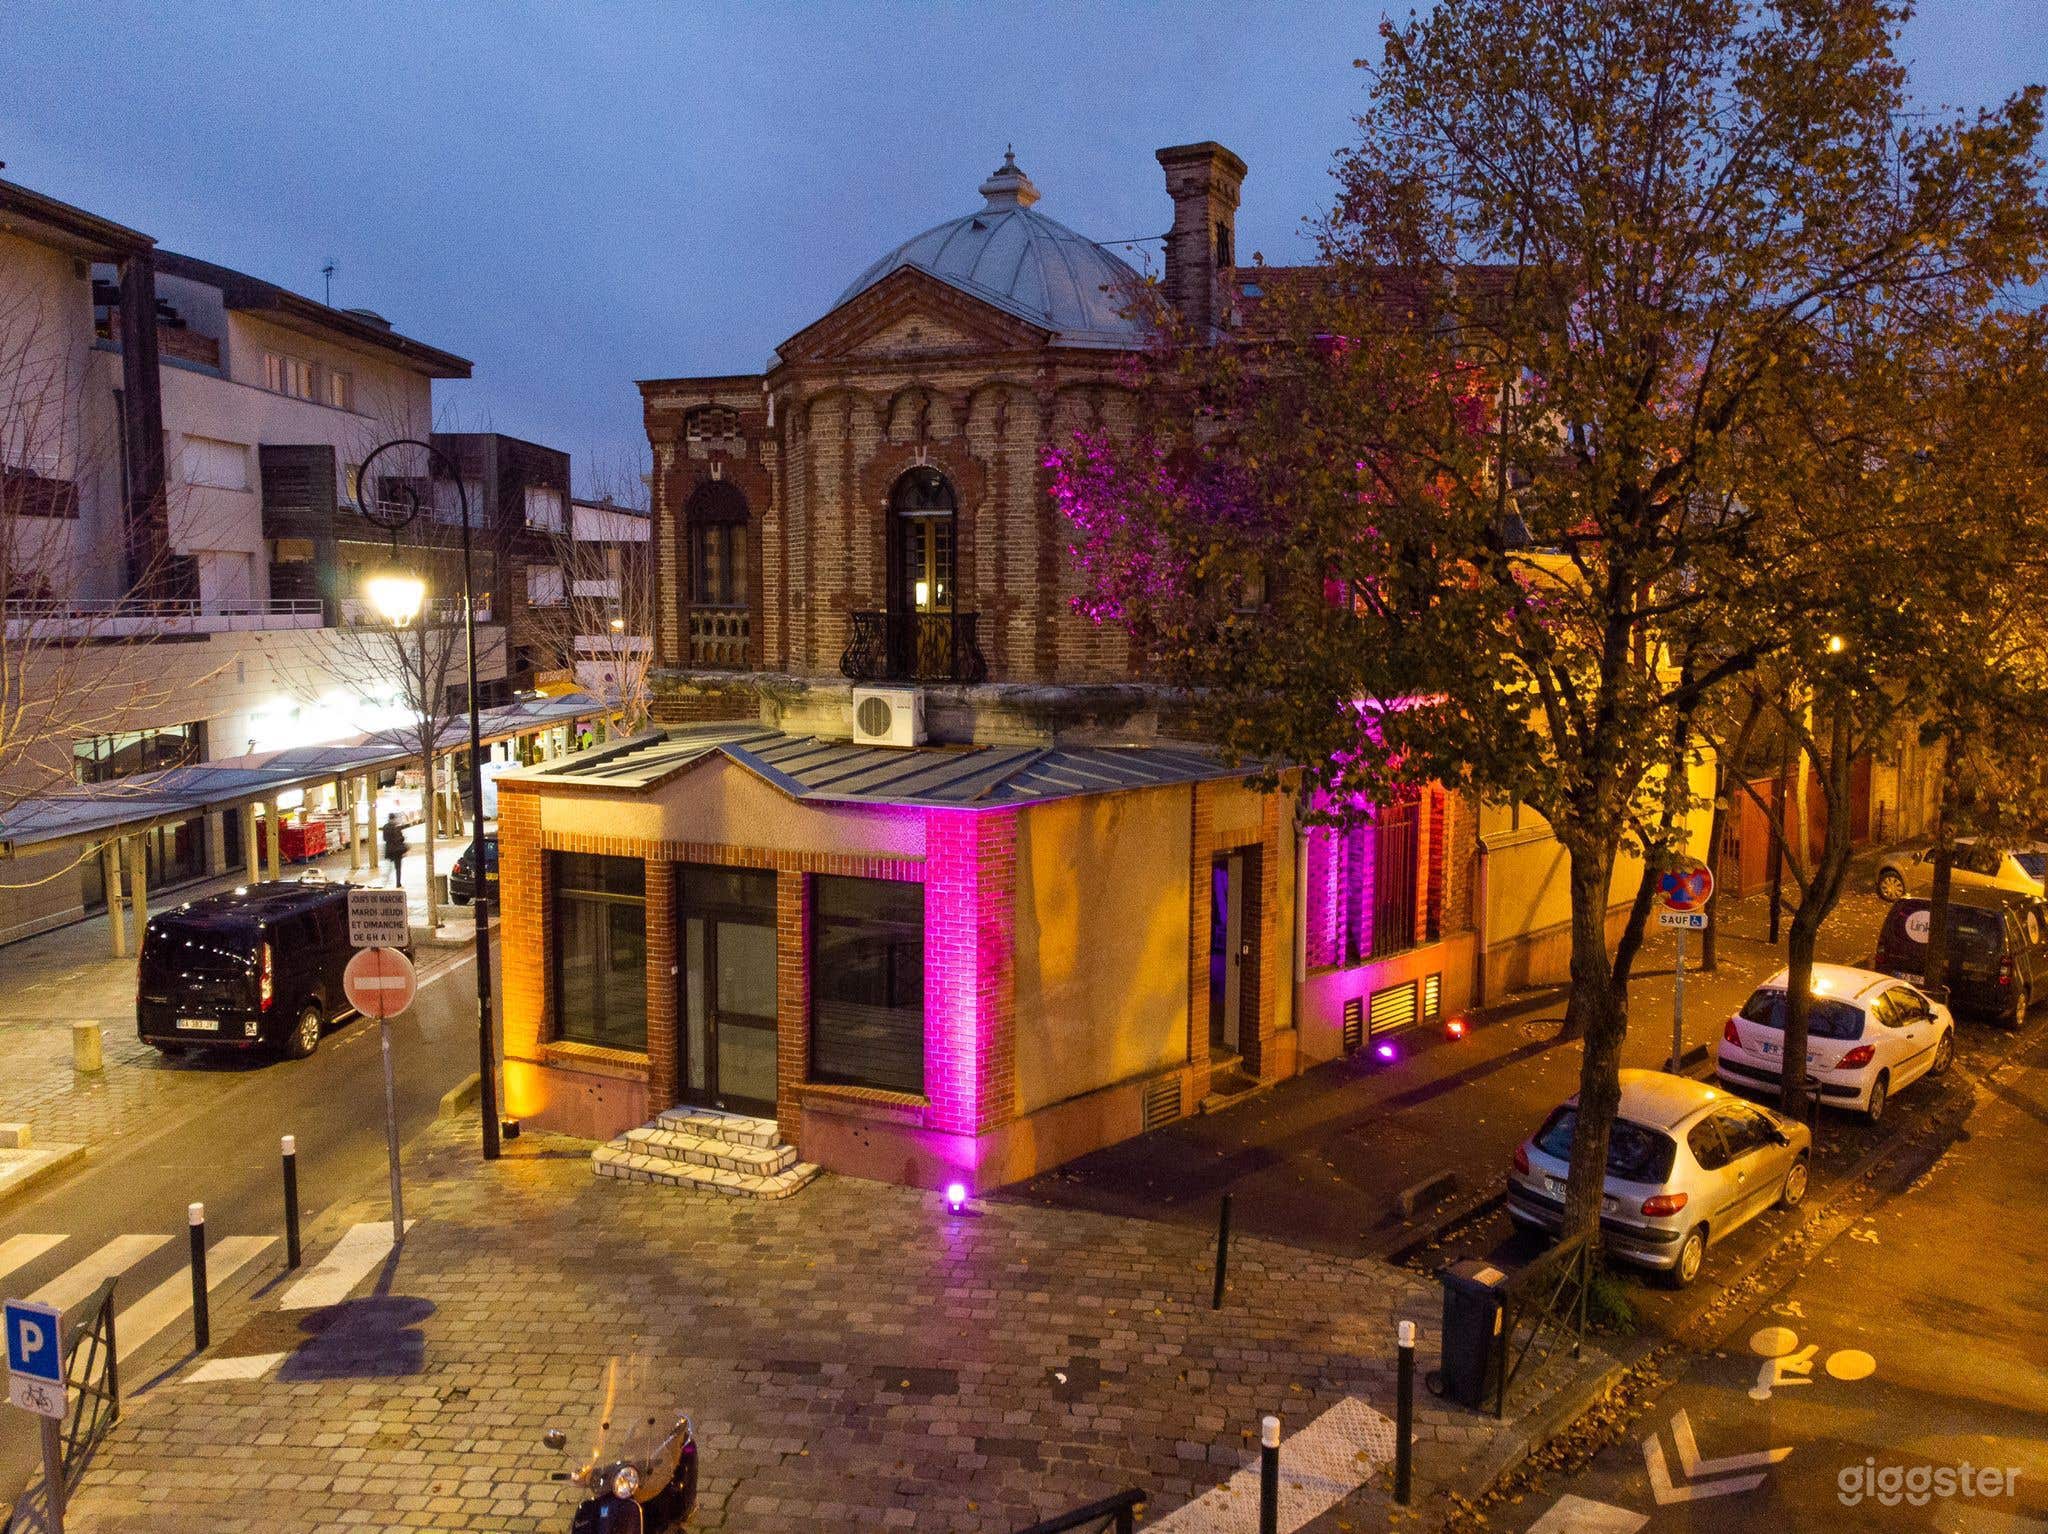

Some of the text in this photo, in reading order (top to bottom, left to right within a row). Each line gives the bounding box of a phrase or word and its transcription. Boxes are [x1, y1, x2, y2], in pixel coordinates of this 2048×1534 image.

[352, 908, 403, 916] MARDI JEUDI
[1661, 915, 1688, 924] SAUF
[352, 921, 403, 929] ET DIMANCHE
[353, 933, 364, 941] DE
[20, 1319, 43, 1363] P
